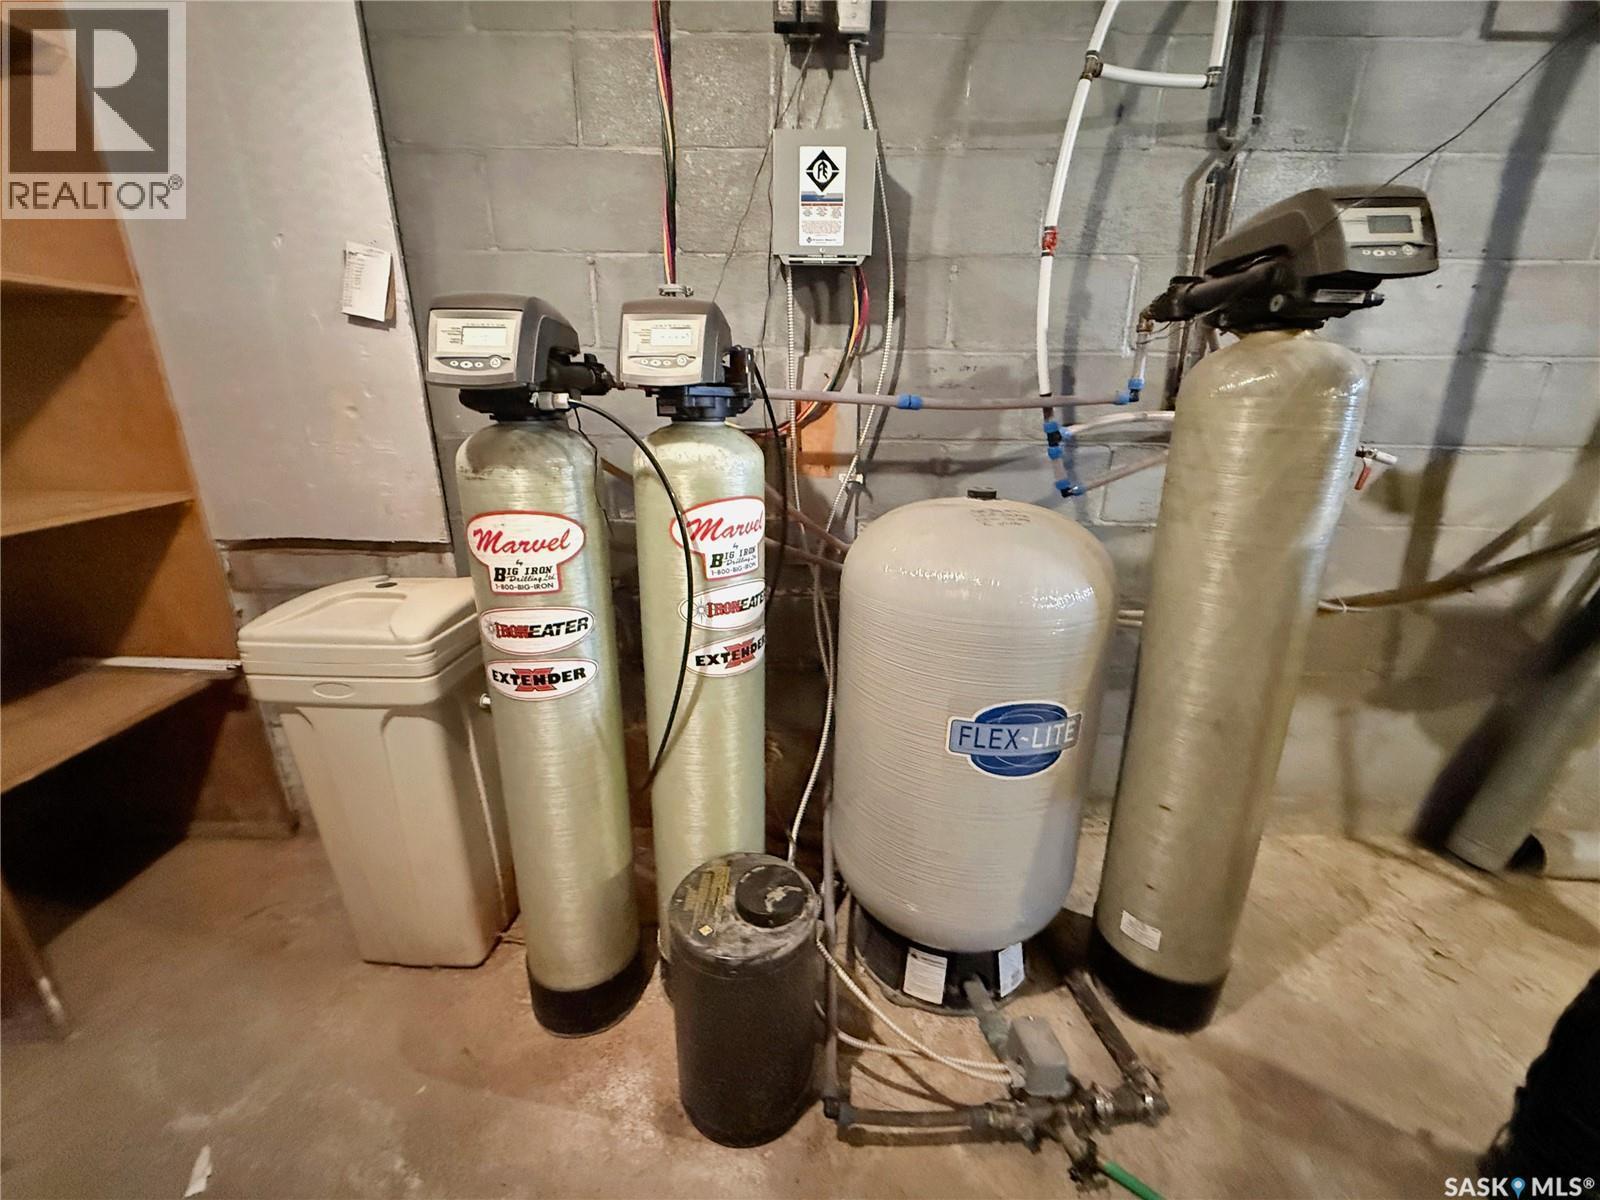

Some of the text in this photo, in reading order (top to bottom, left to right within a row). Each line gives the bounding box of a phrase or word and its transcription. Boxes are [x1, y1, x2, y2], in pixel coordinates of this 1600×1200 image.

[472, 527, 571, 554] Marvel
[709, 551, 735, 569] BIG
[493, 566, 553, 582] BIG IRON
[507, 575, 542, 583] Drilling
[494, 617, 589, 639] IRONEATER
[491, 667, 587, 686] EXTENDER
